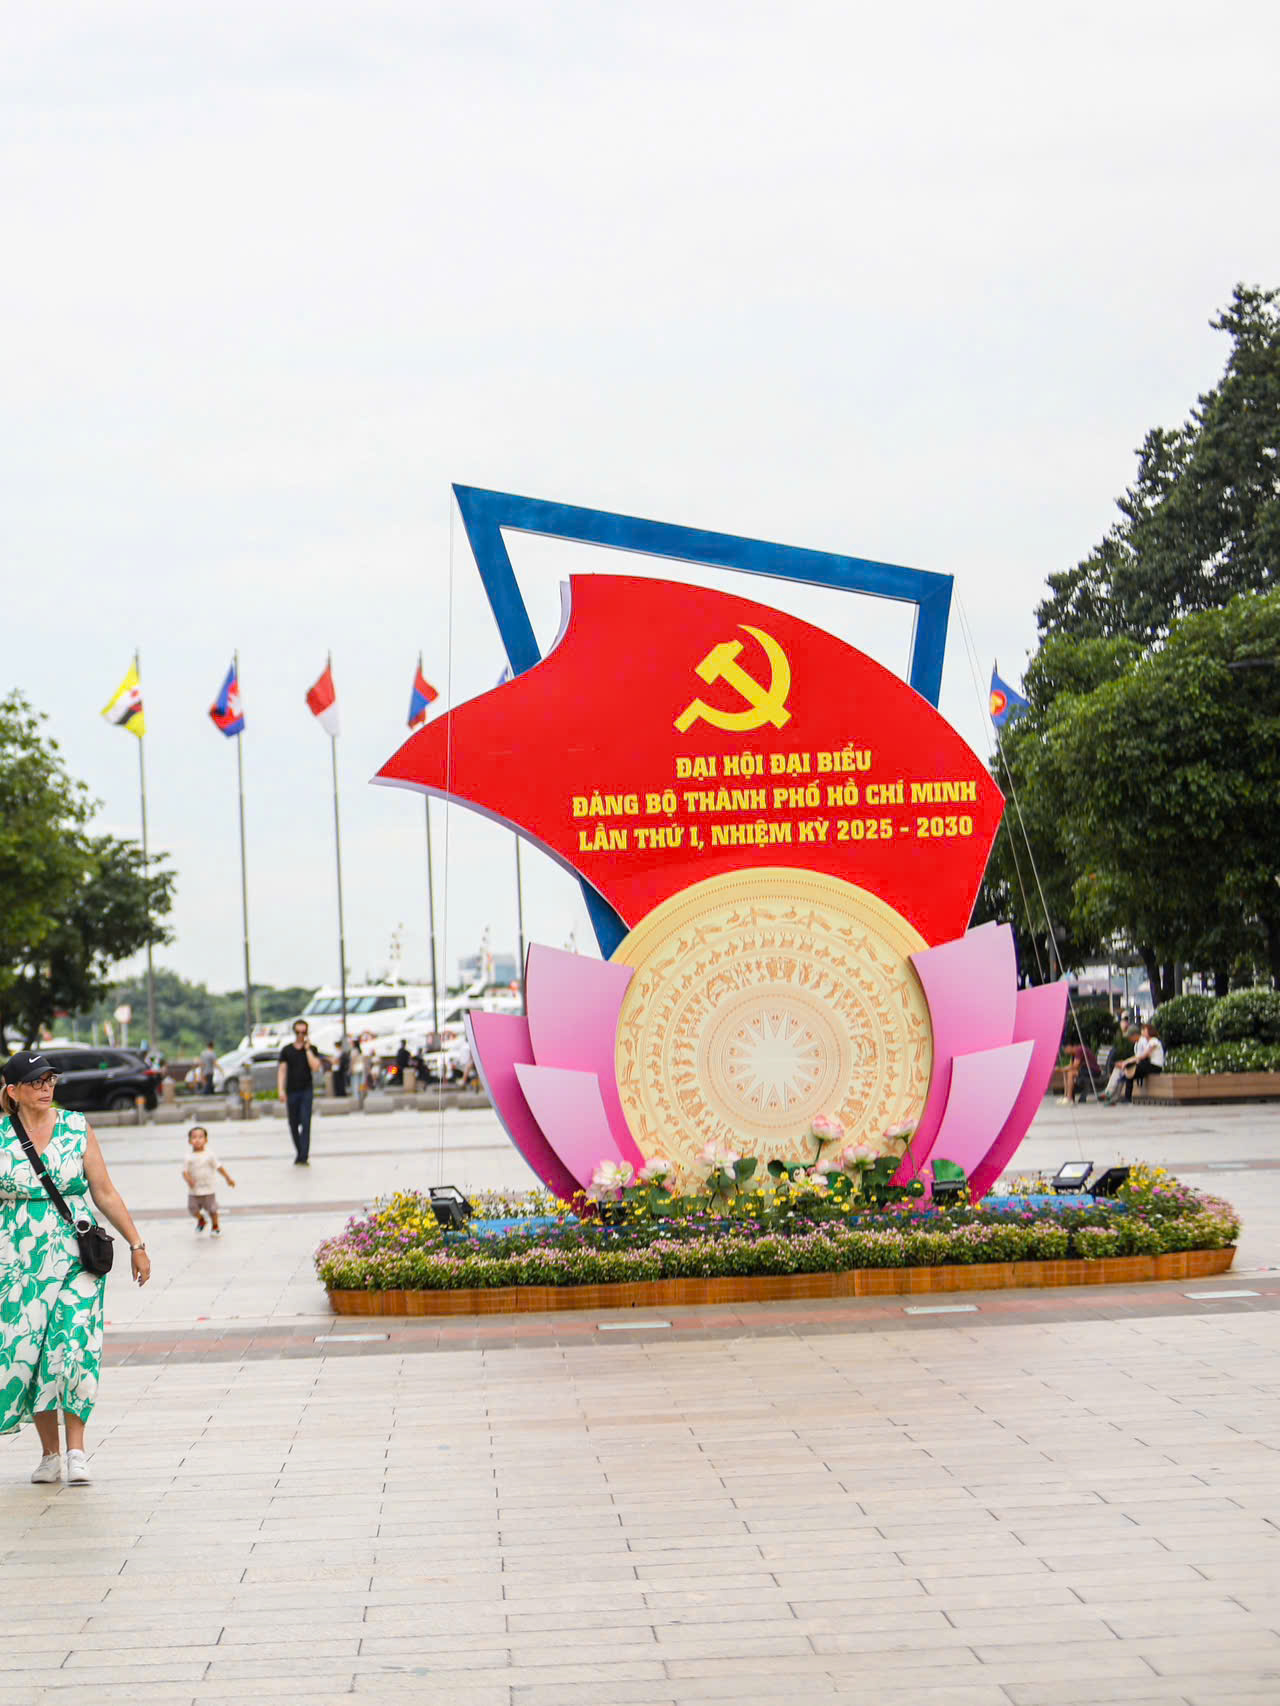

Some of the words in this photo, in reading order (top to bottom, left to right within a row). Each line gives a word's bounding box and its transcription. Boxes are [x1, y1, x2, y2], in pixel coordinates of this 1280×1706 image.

[676, 756, 717, 781] ĐẠI
[723, 751, 764, 779] HỘI
[770, 752, 810, 776] ĐẠI
[817, 742, 872, 772] BIỂU
[572, 789, 640, 817] ĐẢNG
[645, 788, 677, 817] BỘ
[683, 787, 767, 812] THÀNH
[773, 779, 820, 809] PHỐ
[826, 777, 860, 807] HỒ
[866, 779, 905, 805] CHÍ
[910, 780, 977, 804] MINH
[578, 822, 628, 852] LẦN
[633, 823, 685, 849] THỨ
[689, 826, 705, 850] I,
[711, 819, 792, 848] NHIỆM
[798, 816, 830, 843] KỲ
[837, 817, 893, 840] 2025
[916, 815, 973, 838] 2030
